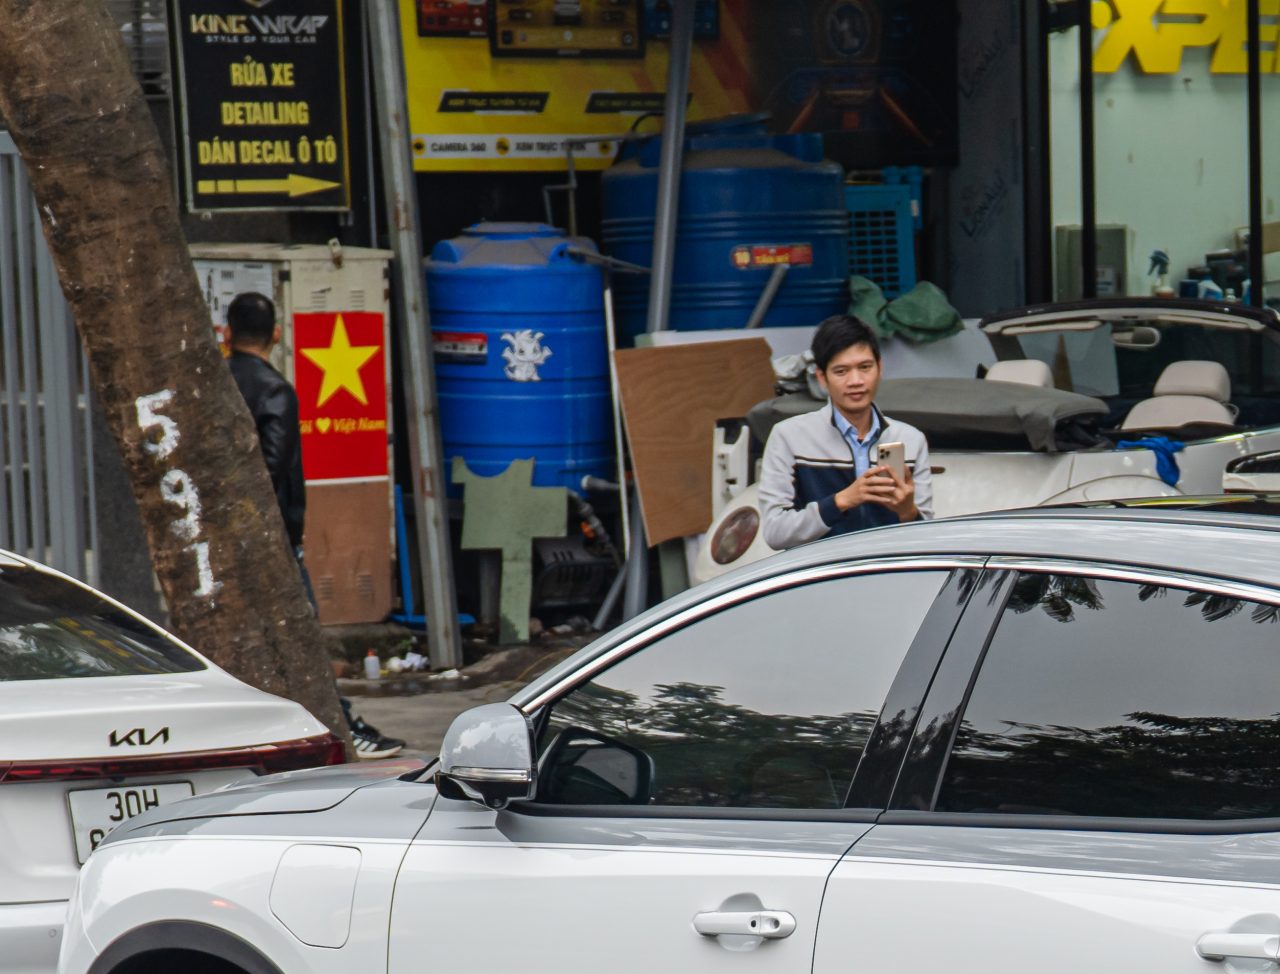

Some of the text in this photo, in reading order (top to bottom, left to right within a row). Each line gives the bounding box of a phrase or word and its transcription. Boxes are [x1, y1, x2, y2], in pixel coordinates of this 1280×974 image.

[190, 14, 329, 34] KING WRAP
[205, 35, 239, 43] STYLE
[243, 35, 257, 43] OF
[230, 55, 295, 86] RỬA XE
[221, 101, 309, 125] DETAILING
[198, 134, 337, 165] DÁN DECAL Ô TÔ
[358, 417, 385, 432] Nam
[109, 727, 170, 748] KIA
[106, 788, 159, 821] 30H
